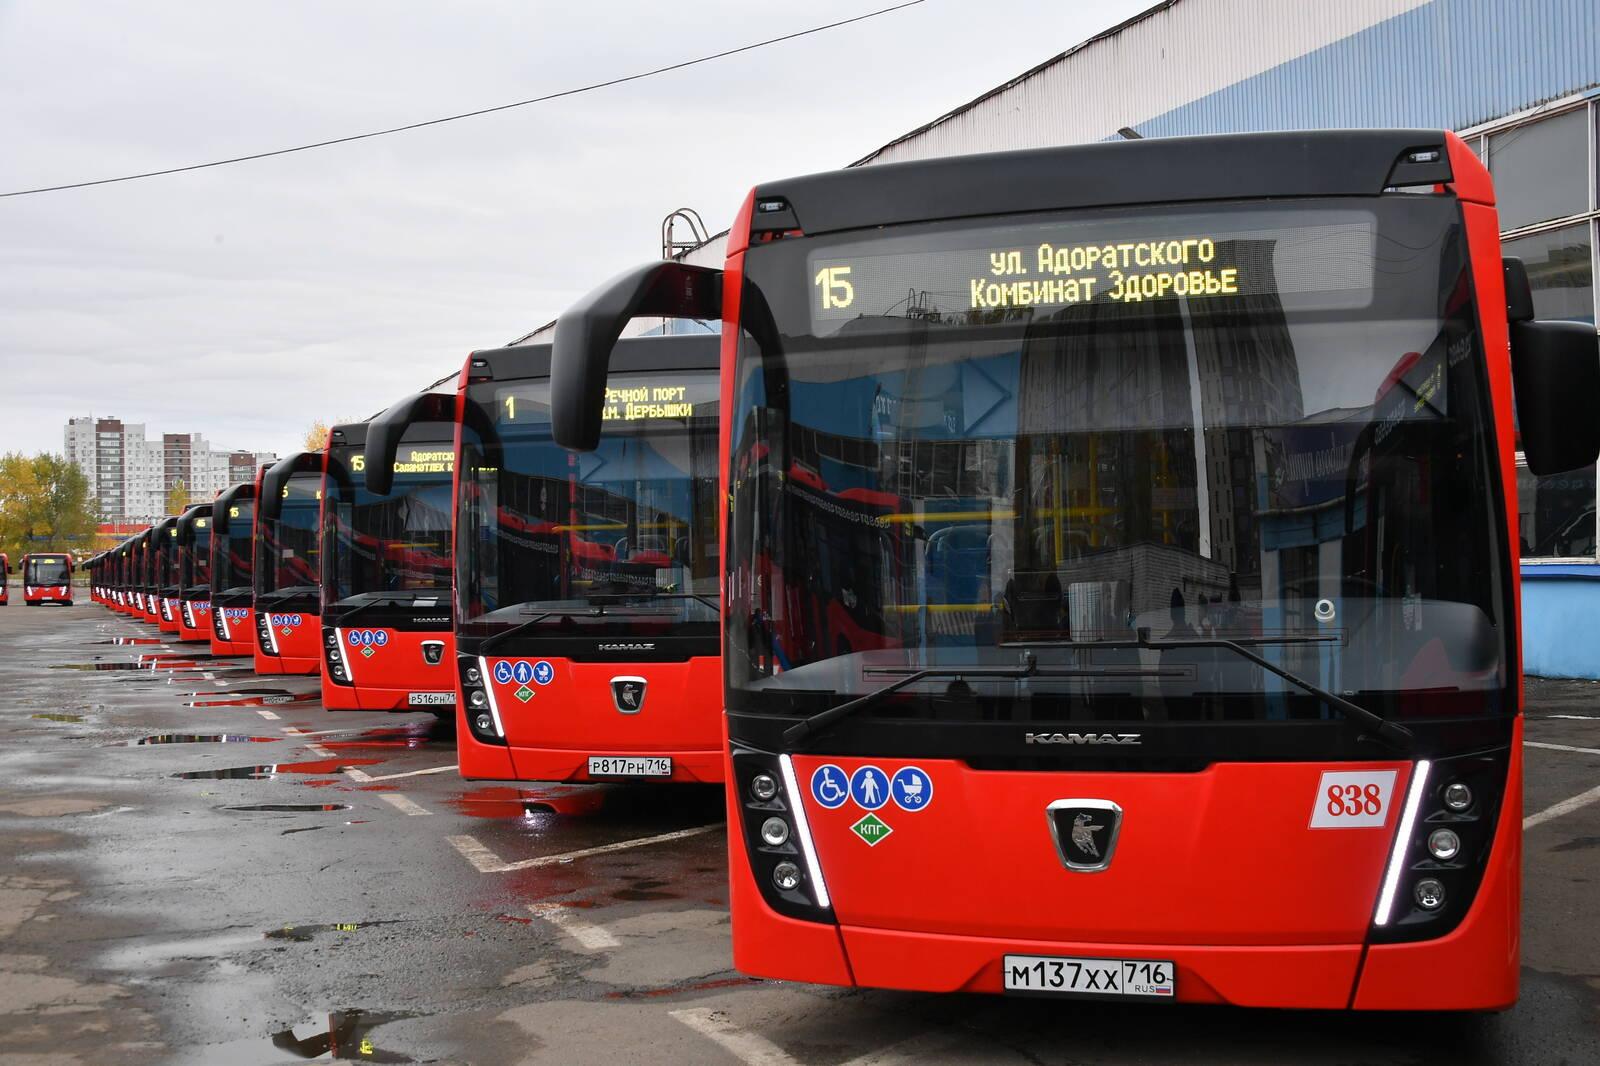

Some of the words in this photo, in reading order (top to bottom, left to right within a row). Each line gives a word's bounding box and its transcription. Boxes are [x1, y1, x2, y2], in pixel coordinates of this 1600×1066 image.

[991, 250, 1027, 276] ул.
[1037, 238, 1215, 276] Адоратского
[814, 265, 855, 309] 15
[970, 276, 1097, 308] Комбинат
[1108, 268, 1238, 302] Здоровье
[505, 396, 515, 419] 1
[350, 455, 366, 471] 15
[1025, 733, 1142, 744] KAMAZ
[593, 759, 645, 774] Р817РН
[647, 759, 668, 771] 716
[1327, 783, 1382, 817] 838
[860, 823, 883, 835] КПГ
[1012, 961, 1118, 990] М137ХХ
[1125, 963, 1166, 984] 716
[1135, 985, 1155, 993] RUS
